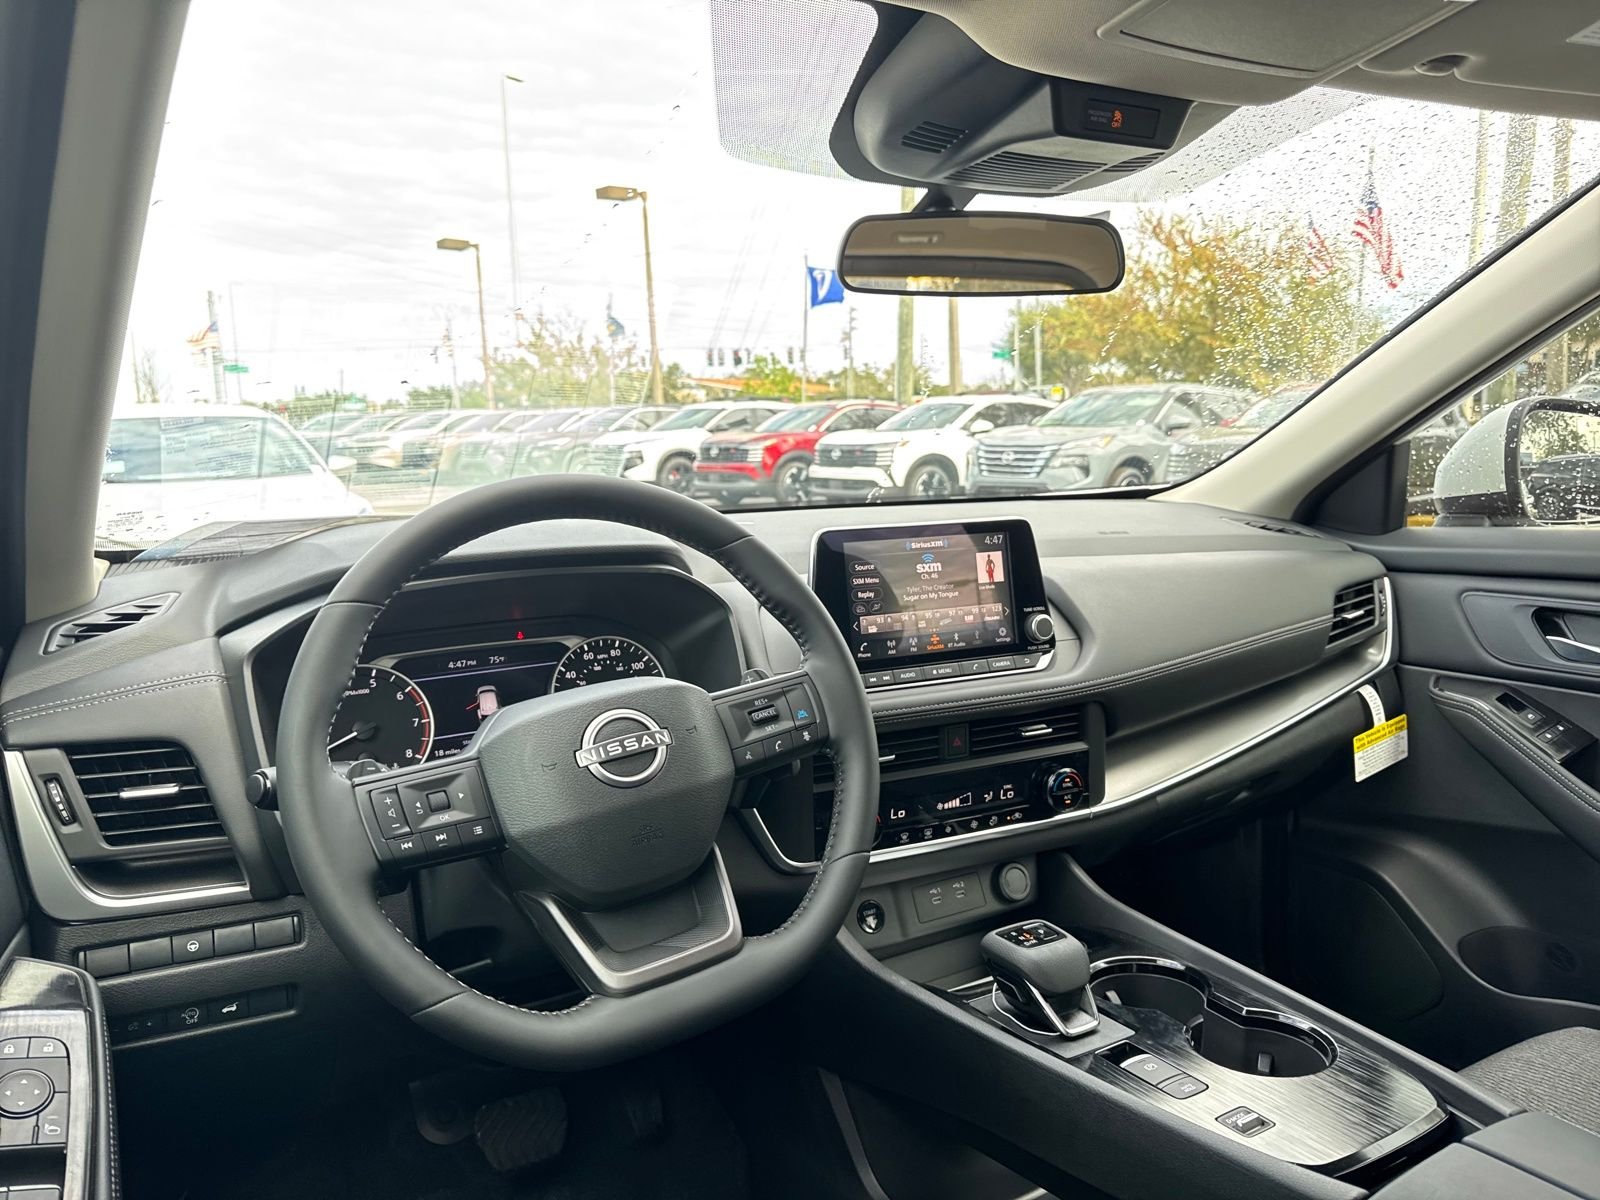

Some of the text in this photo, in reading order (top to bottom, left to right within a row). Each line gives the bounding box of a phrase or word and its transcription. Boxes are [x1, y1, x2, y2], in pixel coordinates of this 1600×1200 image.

[984, 535, 1004, 545] 4:47
[858, 591, 874, 599] Replay
[904, 594, 920, 602] Sugar
[929, 592, 938, 600] My
[939, 591, 958, 599] Tongue
[583, 652, 594, 660] 60
[448, 660, 466, 668] 4:47
[631, 662, 644, 670] 100
[370, 678, 376, 688] 5
[396, 692, 404, 700] 6
[754, 707, 776, 720] CANCEL
[412, 718, 419, 727] 7
[406, 748, 412, 758] 8
[580, 731, 670, 765] NISSAN
[1000, 790, 1014, 800] Lo
[890, 808, 906, 819] Lo
